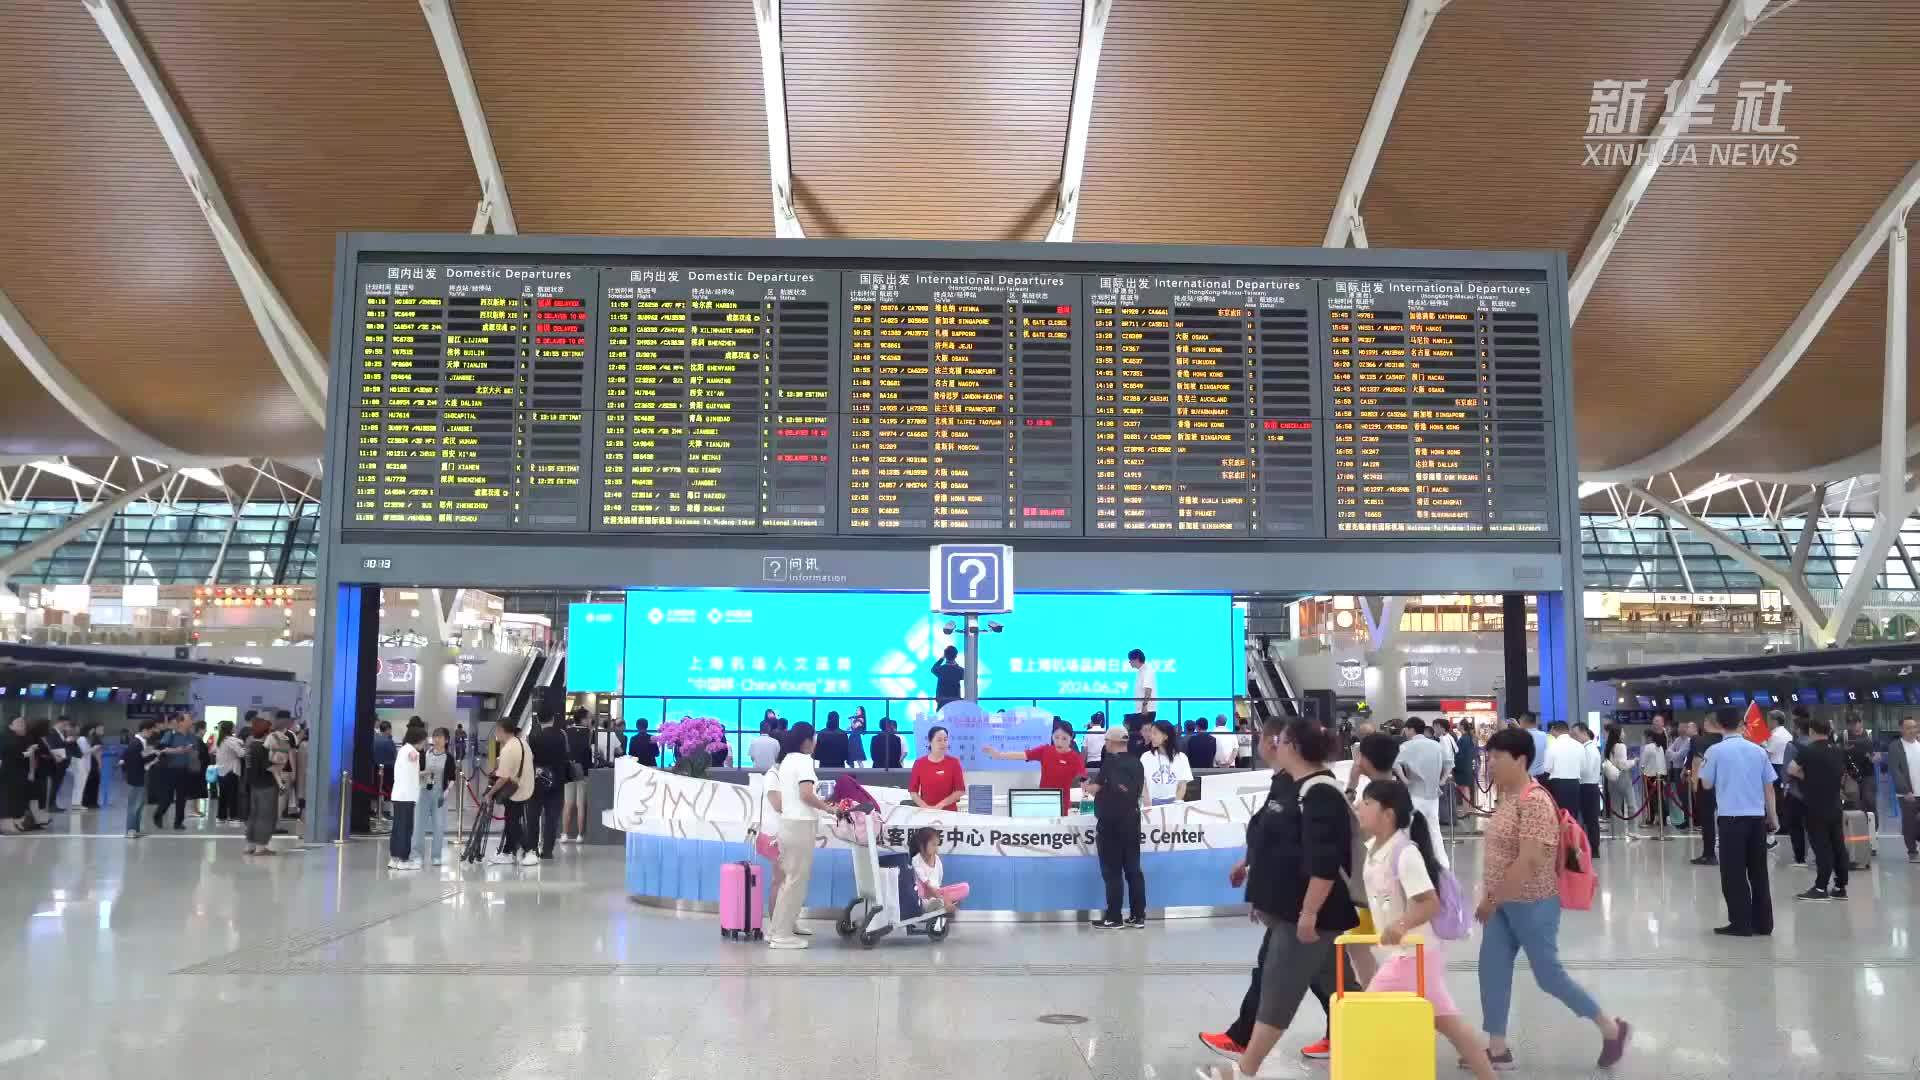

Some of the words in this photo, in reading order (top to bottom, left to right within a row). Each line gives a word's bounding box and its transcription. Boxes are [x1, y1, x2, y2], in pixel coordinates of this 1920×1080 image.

[388, 267, 437, 279] 国内出发
[446, 268, 501, 278] Domestic
[505, 269, 571, 280] Departures
[630, 270, 680, 282] 国内出发
[688, 271, 742, 281] Domestic
[747, 272, 814, 283] Departures
[860, 273, 910, 285] 国际出发
[916, 275, 994, 284] International
[998, 275, 1064, 286] Departures
[1100, 277, 1150, 289] 国际出发
[1155, 279, 1231, 288] International
[1236, 280, 1300, 290] Departures
[1336, 281, 1384, 293] 国际出发
[1389, 283, 1463, 292] International
[1468, 284, 1531, 294] Departures
[789, 557, 818, 570] 问讯
[789, 573, 847, 583] Information
[990, 829, 1079, 849] Passenger
[1150, 828, 1205, 844] Center
